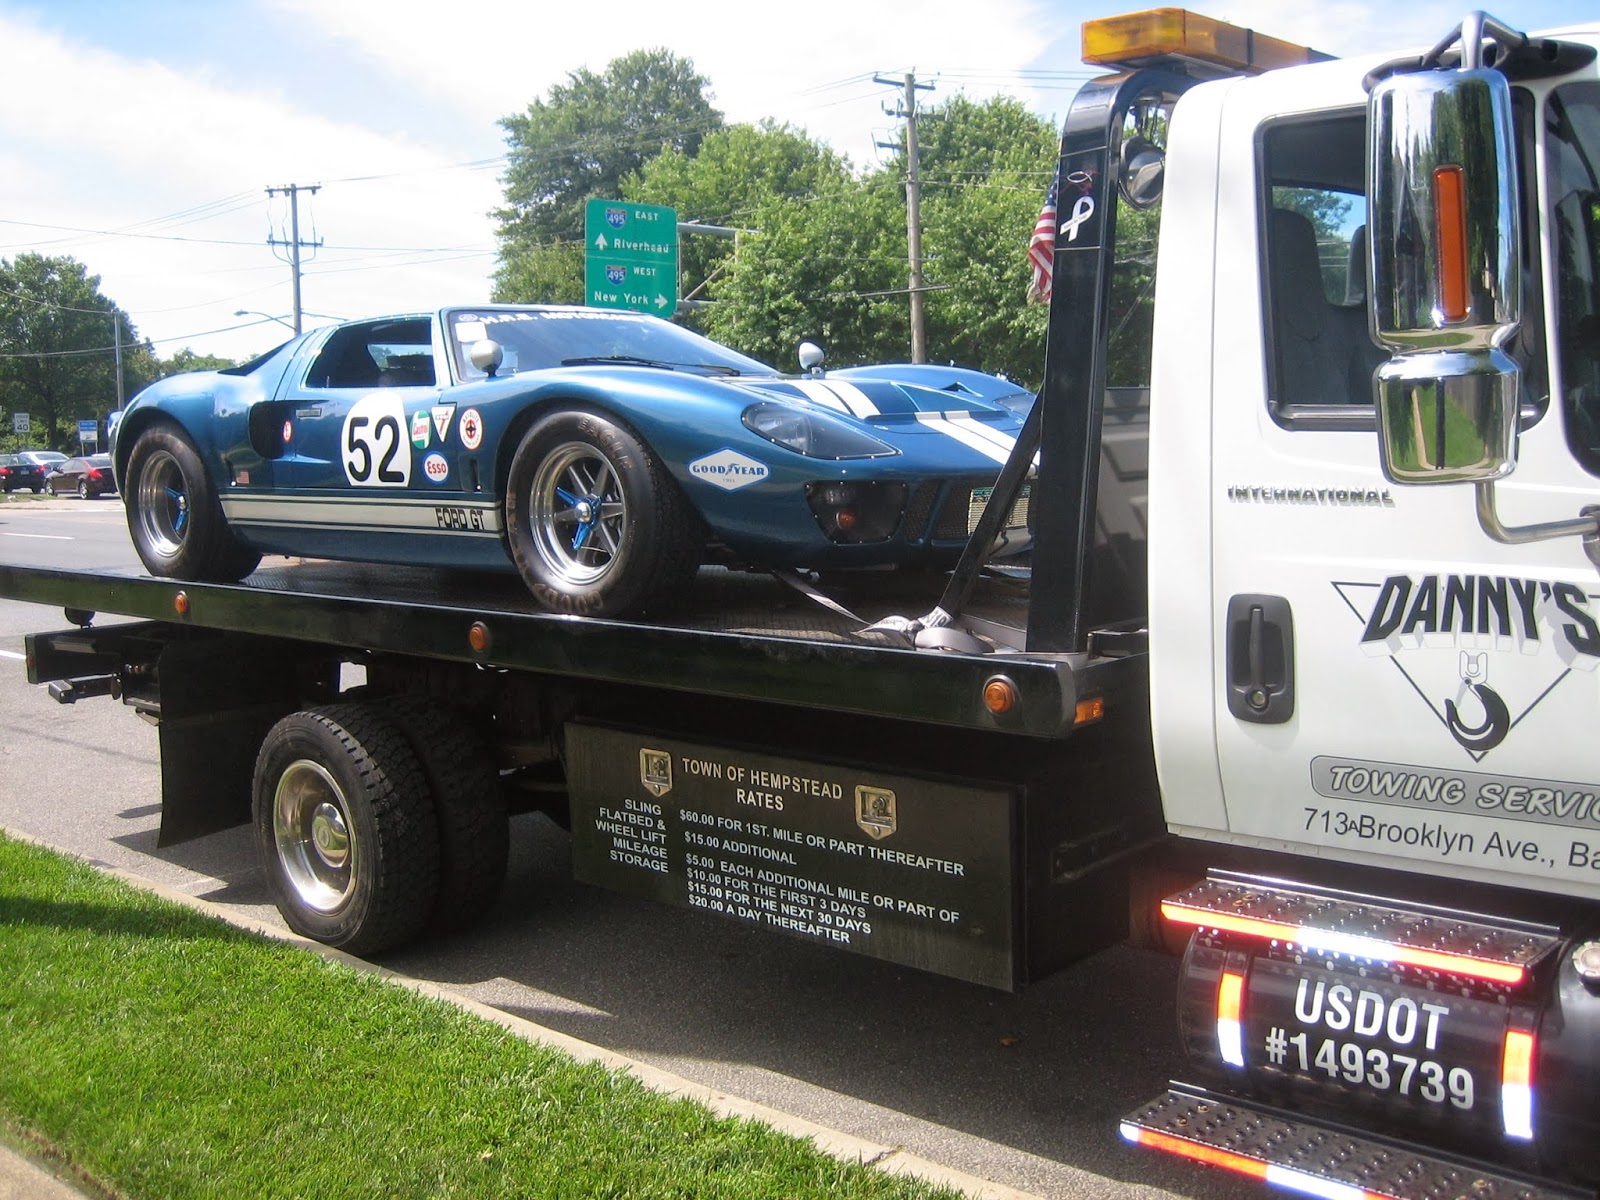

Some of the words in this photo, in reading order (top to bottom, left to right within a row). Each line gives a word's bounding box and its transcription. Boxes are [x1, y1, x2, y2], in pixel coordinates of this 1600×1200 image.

[608, 214, 625, 224] 495
[635, 211, 659, 221] EAST
[614, 238, 669, 253] Riverhead
[608, 270, 625, 281] 495
[633, 267, 656, 276] WEST
[594, 291, 617, 302] New
[624, 293, 648, 305] York
[348, 415, 404, 482] 52
[1228, 486, 1394, 504] INTERNATIONAL
[435, 507, 468, 529] FORD
[470, 509, 484, 530] GT
[1361, 574, 1600, 661] DANNY'S
[682, 758, 721, 778] TOWN
[727, 766, 745, 782] OF
[750, 770, 842, 800] HEMPSTEAD
[1330, 766, 1465, 805] TOWING
[625, 799, 661, 815] SLING
[736, 788, 784, 811] RATES
[595, 819, 638, 838] WHEEL
[641, 830, 666, 844] LIFT
[600, 807, 653, 828] FLATBED
[657, 820, 666, 830] &
[613, 837, 668, 859] MILEAGE
[679, 809, 714, 826] $60.00
[718, 816, 742, 832] FOR
[745, 822, 770, 838] 1ST.
[773, 827, 802, 844] MILE
[806, 834, 826, 849] OR
[829, 838, 864, 856] PART
[868, 846, 964, 876] THEREAFTER
[684, 831, 719, 848] $15.00
[722, 839, 797, 865] ADDITIONAL
[1482, 832, 1554, 868] Ave.,
[610, 850, 669, 873] STORAGE
[686, 853, 714, 869] $5.00
[720, 861, 754, 878] EACH
[757, 869, 834, 896] ADDITIONAL
[838, 886, 869, 905] MILE
[873, 894, 894, 910] OR
[898, 899, 935, 919] PART
[939, 909, 959, 924] OF
[687, 867, 721, 885] $10.00
[724, 876, 749, 891] FOR
[752, 882, 776, 898] THE
[780, 889, 816, 907] FIRST
[819, 898, 826, 909] 3
[831, 900, 866, 918] DAYS
[688, 881, 722, 898] $15.00
[725, 890, 750, 905] FOR
[753, 896, 777, 912] THE
[781, 903, 814, 920] NEXT
[818, 912, 832, 925] 30
[836, 916, 871, 934] DAYS
[688, 894, 723, 912] $20.00
[726, 904, 735, 914] A
[738, 906, 762, 921] DAY
[765, 912, 850, 944] THEREAFTER
[1294, 978, 1449, 1050] USDOT
[1265, 1026, 1474, 1110] #1493739
